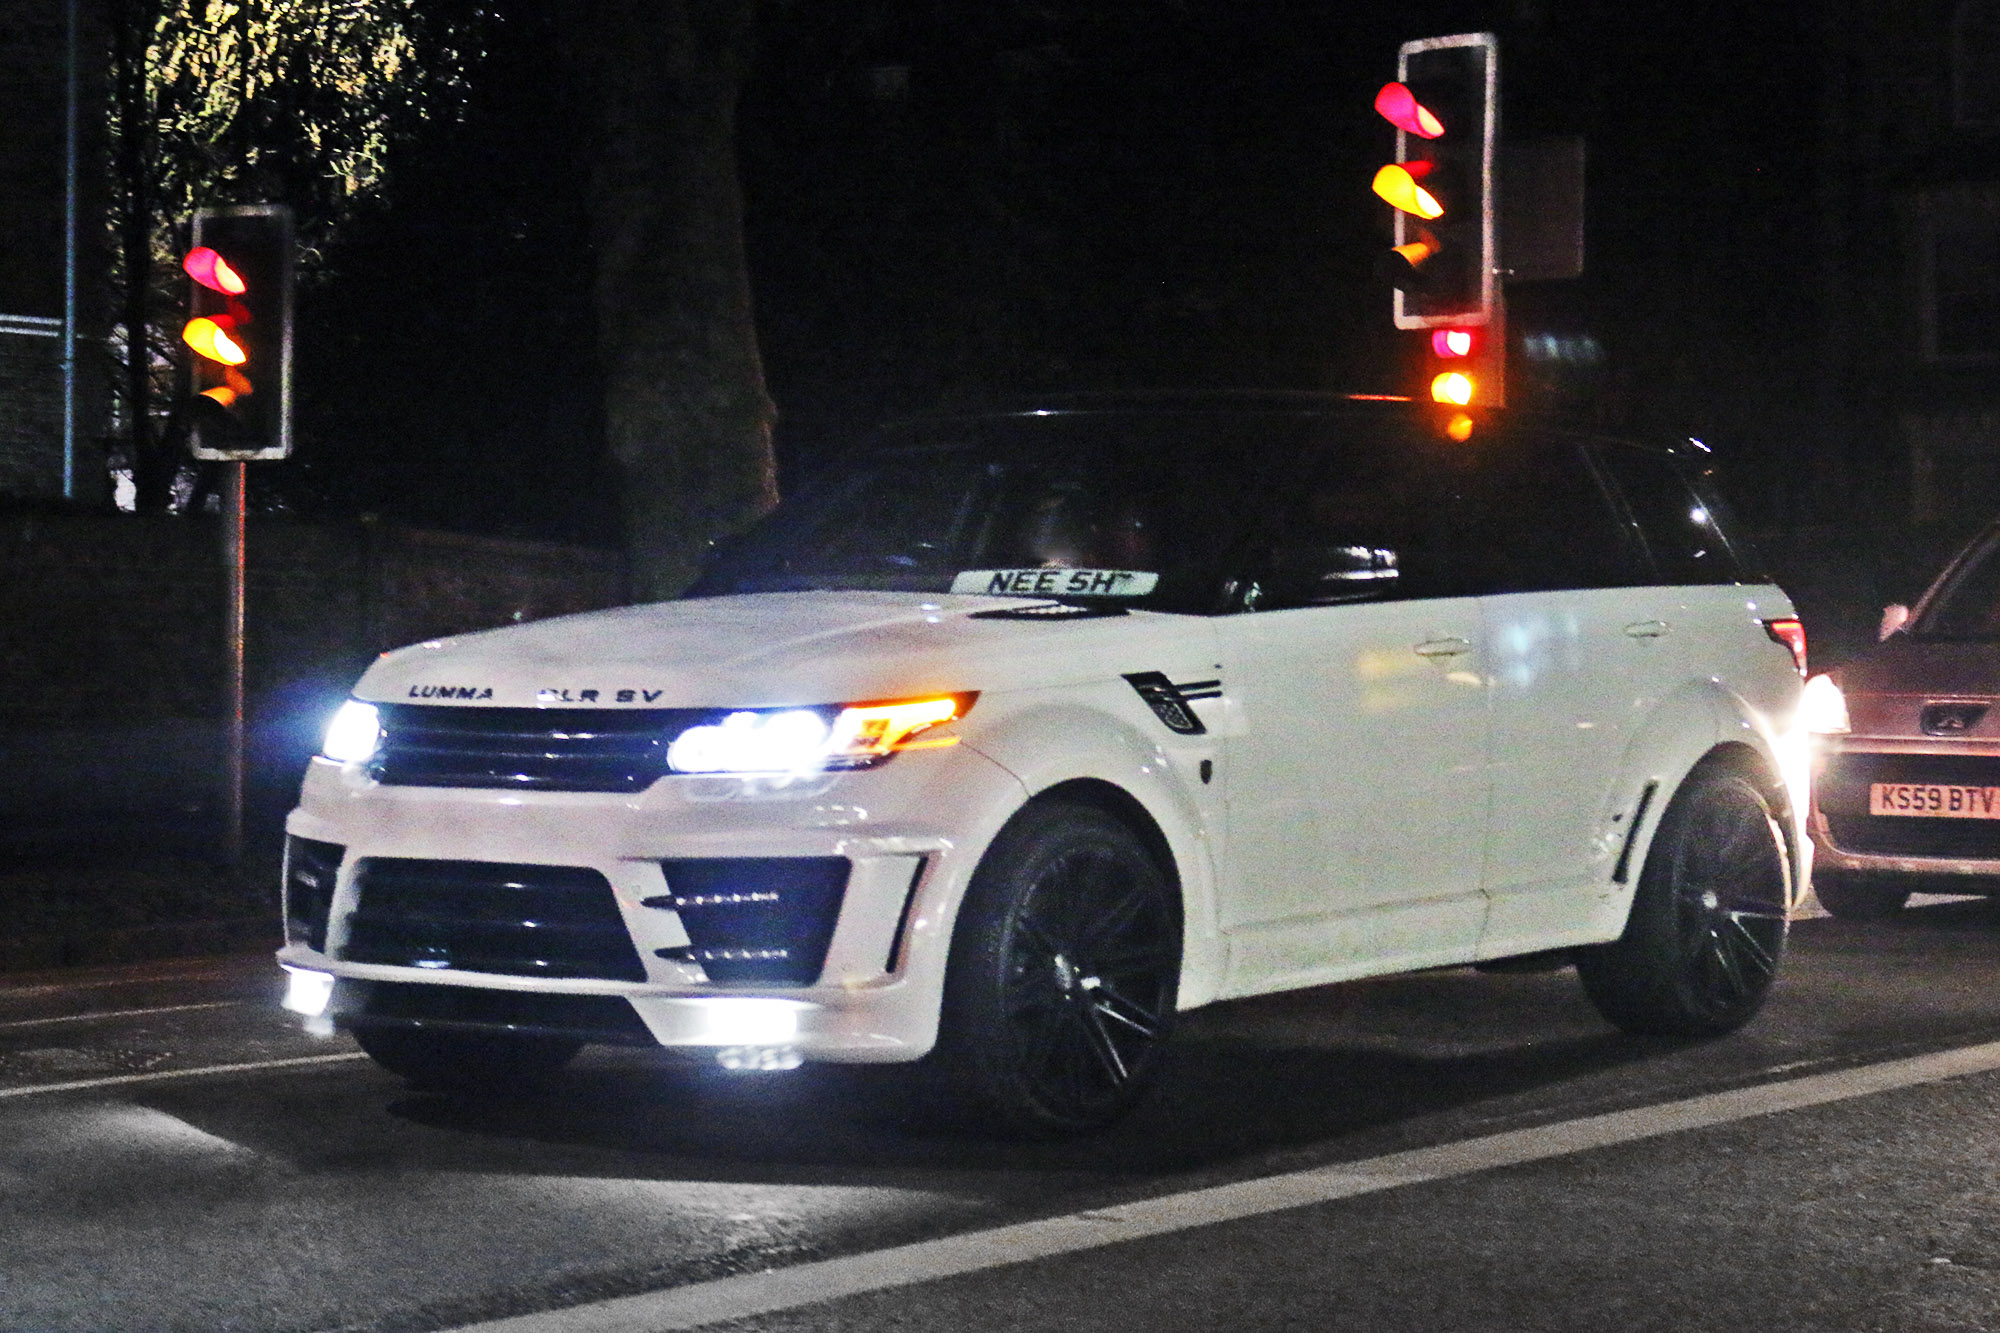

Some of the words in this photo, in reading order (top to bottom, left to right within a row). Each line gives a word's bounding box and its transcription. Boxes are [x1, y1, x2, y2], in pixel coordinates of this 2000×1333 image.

[988, 571, 1061, 593] NEE
[408, 685, 493, 699] LUMMA
[1881, 786, 1941, 810] KS59
[1949, 788, 1994, 813] BTV
